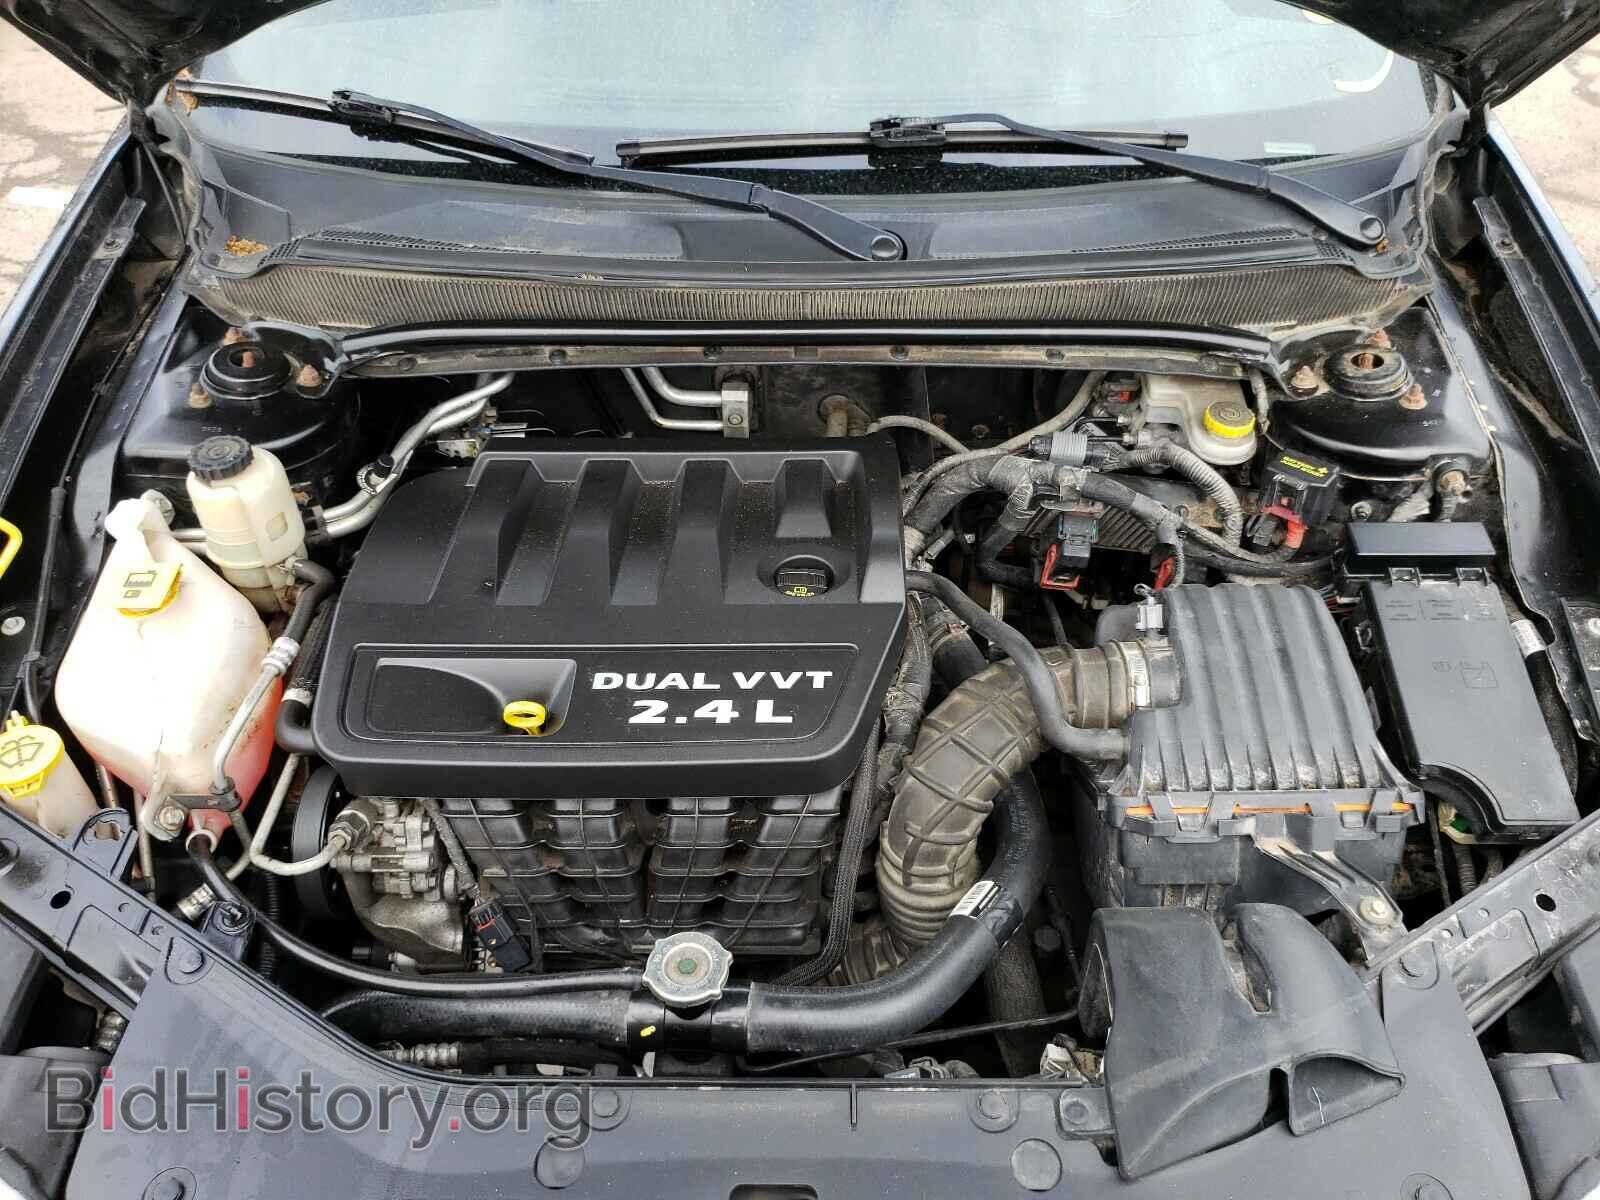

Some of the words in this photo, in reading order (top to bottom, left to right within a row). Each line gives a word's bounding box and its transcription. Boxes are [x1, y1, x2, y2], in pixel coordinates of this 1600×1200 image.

[591, 672, 721, 691] DUAL
[732, 671, 833, 690] VVT
[628, 699, 740, 724] 2.4
[754, 699, 793, 724] L
